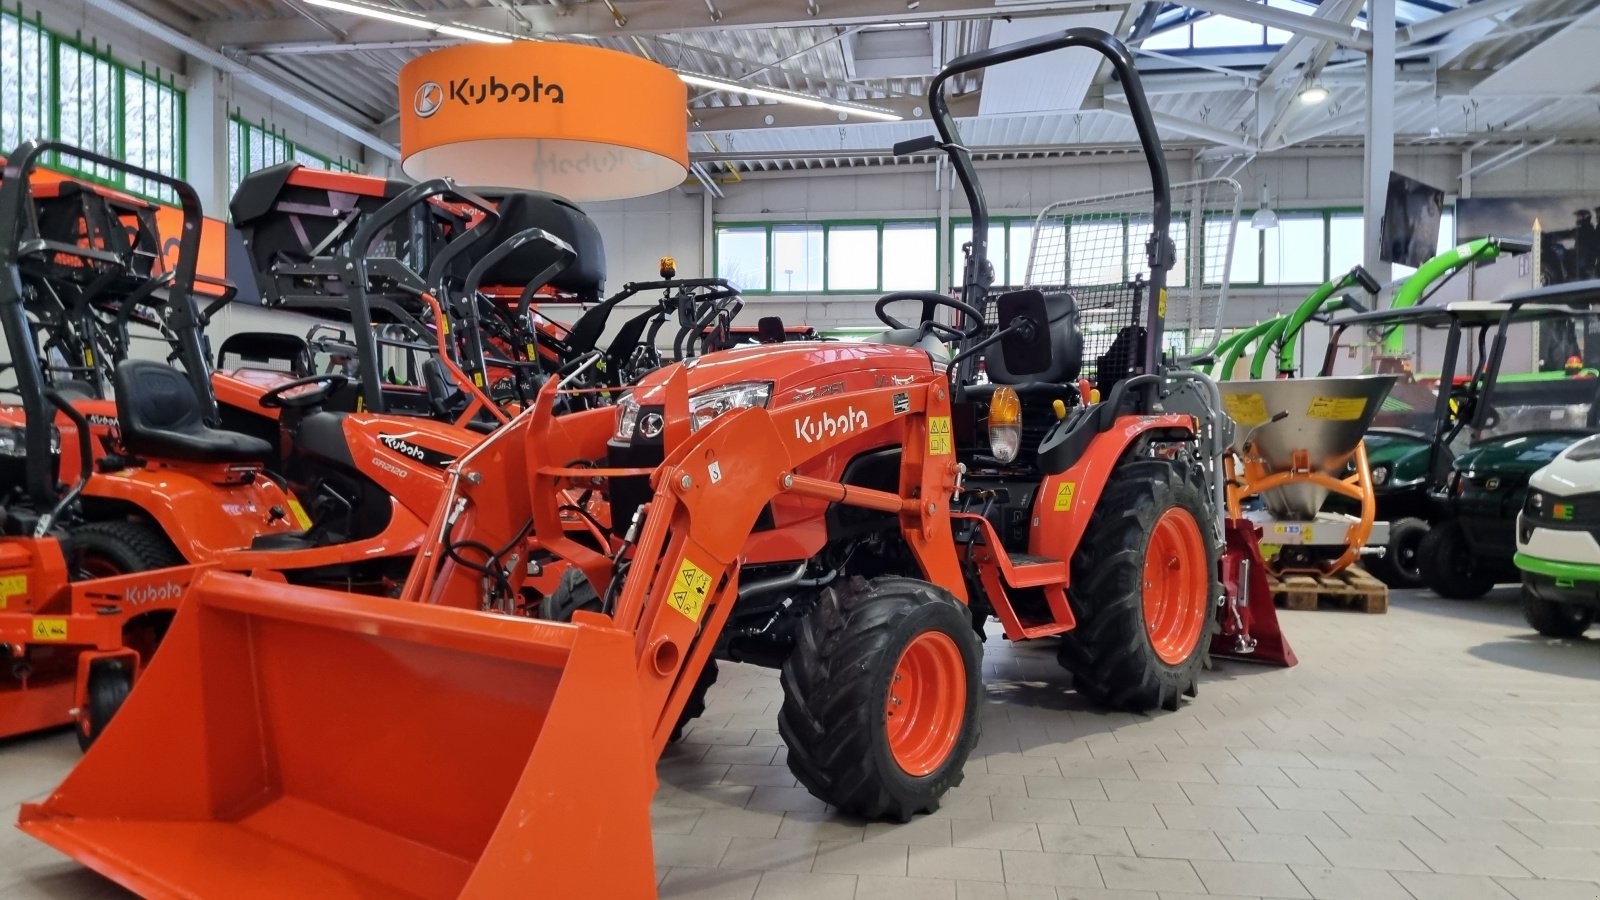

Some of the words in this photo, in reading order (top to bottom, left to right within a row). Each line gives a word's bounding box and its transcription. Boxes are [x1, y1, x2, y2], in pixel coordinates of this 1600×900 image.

[450, 75, 564, 106] Kubota
[795, 405, 869, 443] Kubota
[384, 436, 425, 461] Kubota
[371, 457, 408, 479] GR2120
[126, 582, 181, 606] Kubota
